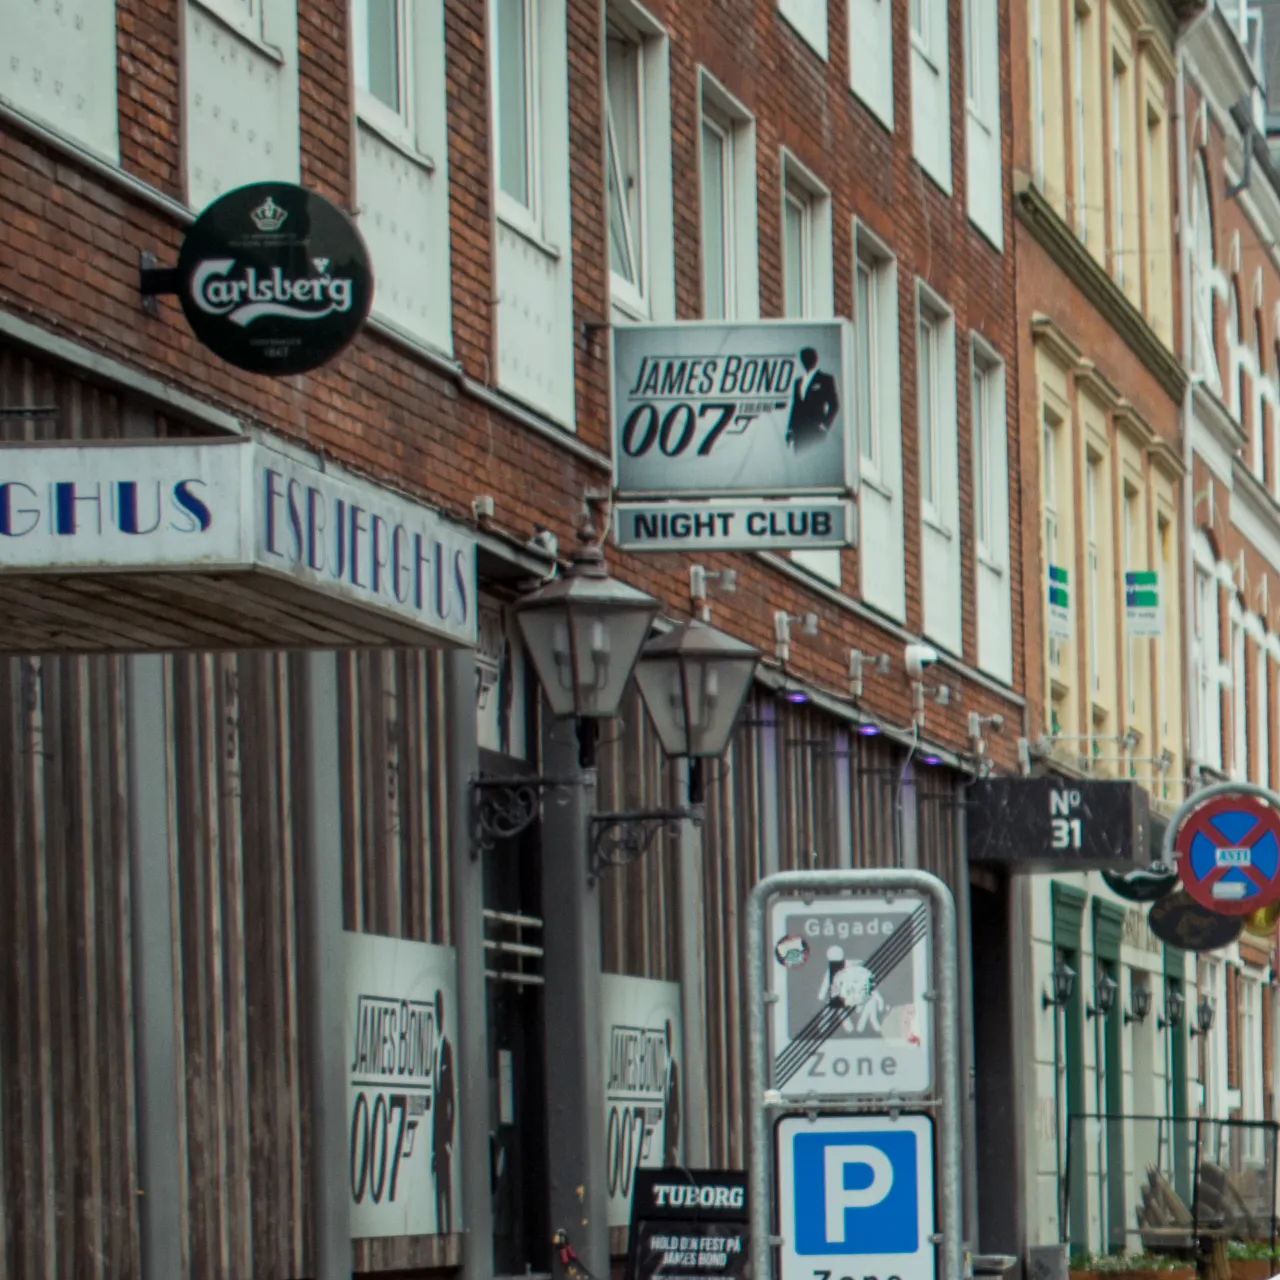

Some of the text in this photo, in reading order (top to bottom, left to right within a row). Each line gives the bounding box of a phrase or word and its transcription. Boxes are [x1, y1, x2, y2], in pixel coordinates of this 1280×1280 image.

[191, 257, 354, 316] Carlsberg
[629, 354, 795, 396] JAMES BOND
[621, 402, 737, 458] 007
[633, 509, 832, 540] NIGHT CLUB
[1050, 818, 1082, 849] 31
[804, 917, 895, 939] Gågade
[351, 996, 434, 1078] JAMES BOND
[807, 1051, 898, 1078] Zone
[350, 1091, 408, 1205] 007
[652, 1184, 745, 1209] TUBORG
[823, 1143, 895, 1244] P
